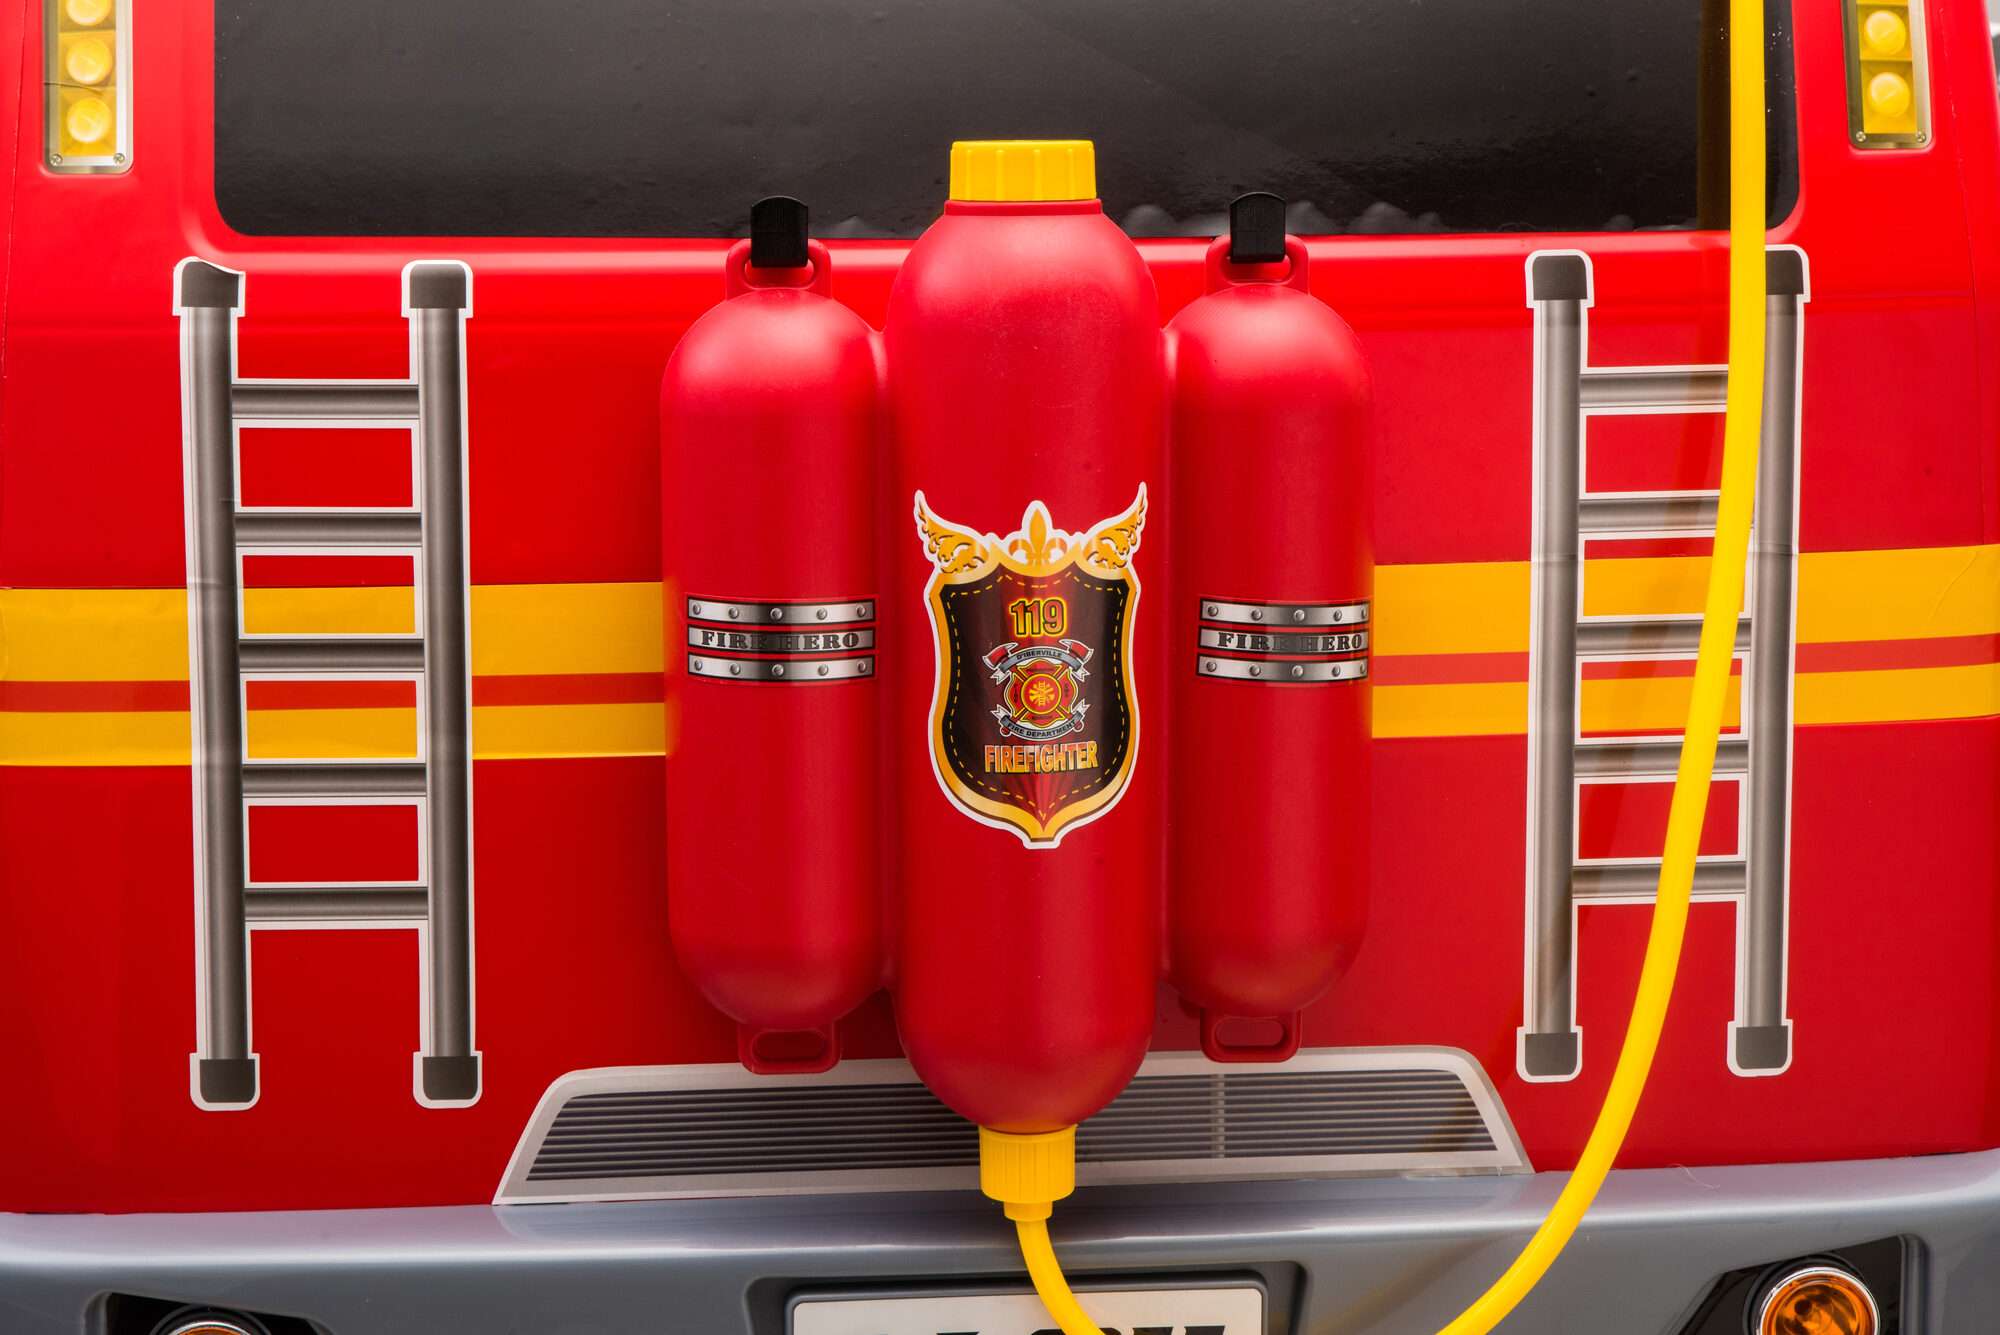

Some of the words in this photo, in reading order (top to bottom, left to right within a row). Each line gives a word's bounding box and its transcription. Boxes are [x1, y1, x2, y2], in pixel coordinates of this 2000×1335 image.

[1010, 597, 1067, 636] 119
[701, 630, 769, 650] FIRE
[778, 632, 860, 650] HERO
[1303, 633, 1363, 651] HERO
[1007, 722, 1024, 735] FIRE
[1025, 720, 1075, 737] DEPARTMENT
[984, 741, 1099, 773] FIREFIGHTER
